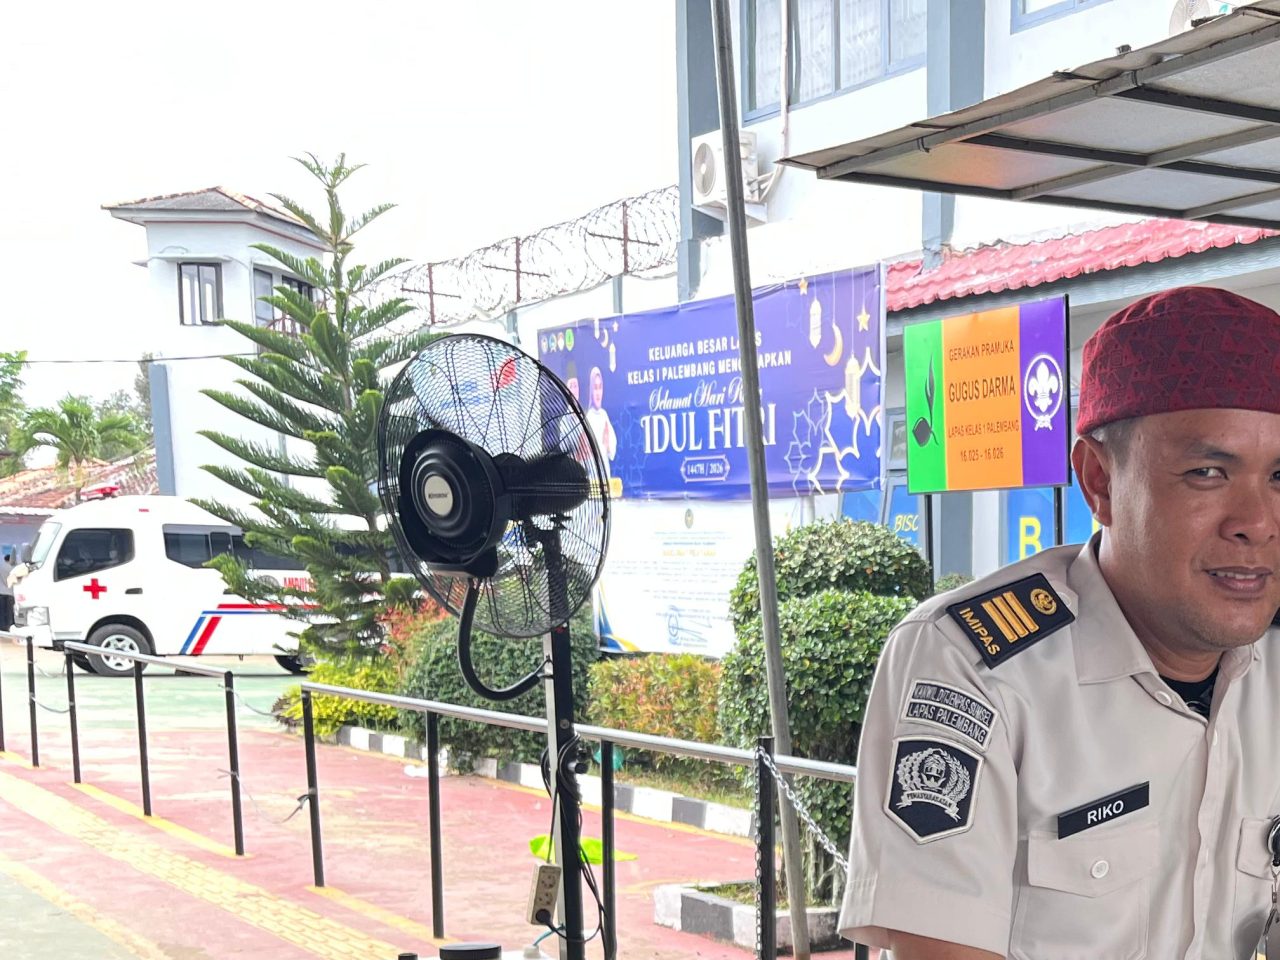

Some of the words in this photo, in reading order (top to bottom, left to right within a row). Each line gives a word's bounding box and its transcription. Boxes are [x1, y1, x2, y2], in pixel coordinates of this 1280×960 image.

[649, 342, 695, 362] KELUARGA
[697, 336, 728, 355] BESAR
[949, 345, 980, 362] GERAKAN
[981, 339, 1015, 357] PRAMUKA
[628, 370, 655, 385] KELAS
[662, 360, 715, 381] PALEMBANG
[649, 386, 692, 411] Selamat
[694, 379, 727, 407] Hari
[949, 380, 980, 402] GUGUS
[982, 376, 1016, 399] DARMA
[640, 411, 702, 454] IDUL
[707, 403, 777, 450] FITI
[987, 419, 1020, 433] PALEMBANG
[709, 462, 724, 475] 2026
[959, 607, 1001, 655] IMIPAS
[907, 703, 936, 719] LAPAS
[935, 708, 986, 743] PALEMBANG
[1087, 800, 1124, 825] RIKO
